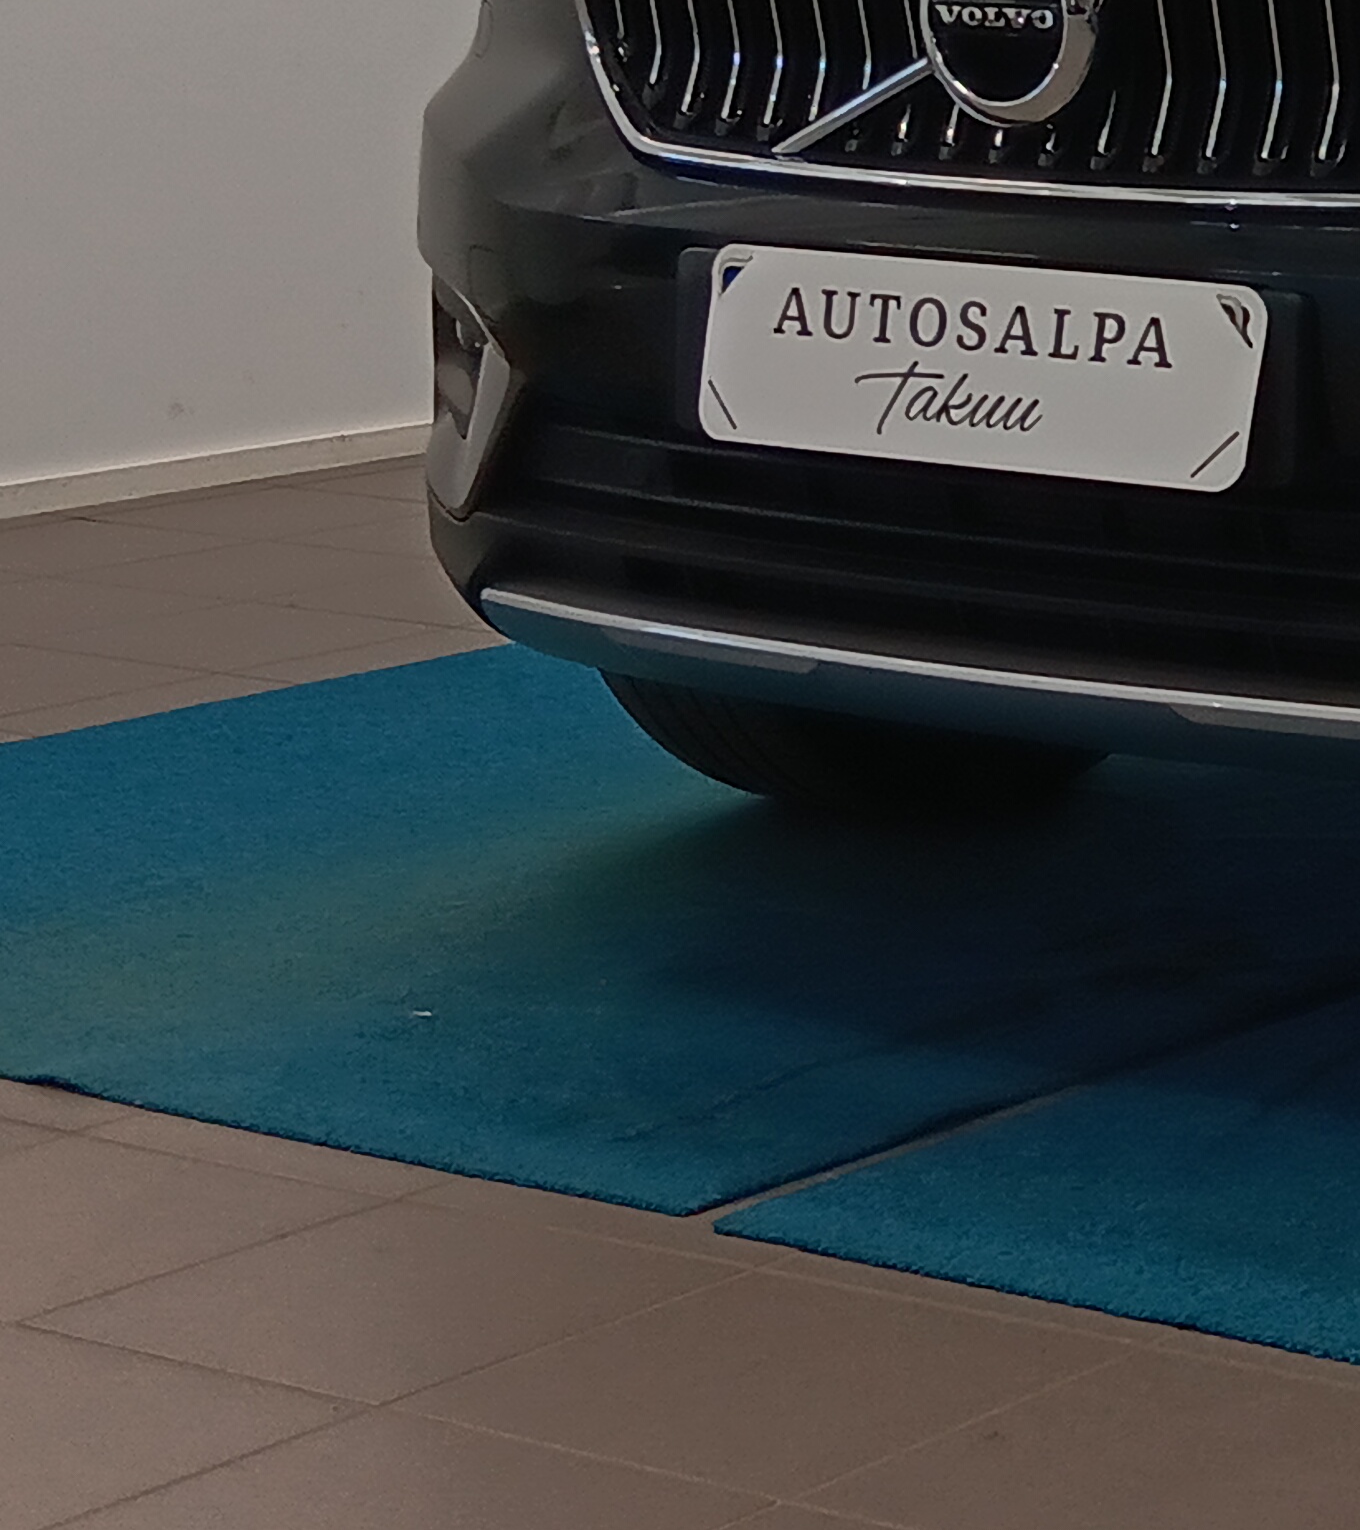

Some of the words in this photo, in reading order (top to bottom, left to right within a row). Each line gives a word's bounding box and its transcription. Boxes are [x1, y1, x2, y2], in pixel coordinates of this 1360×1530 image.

[934, 3, 1055, 29] VOLVO
[773, 286, 1174, 369] AUTOSALPA
[854, 360, 1043, 435] Takuu
